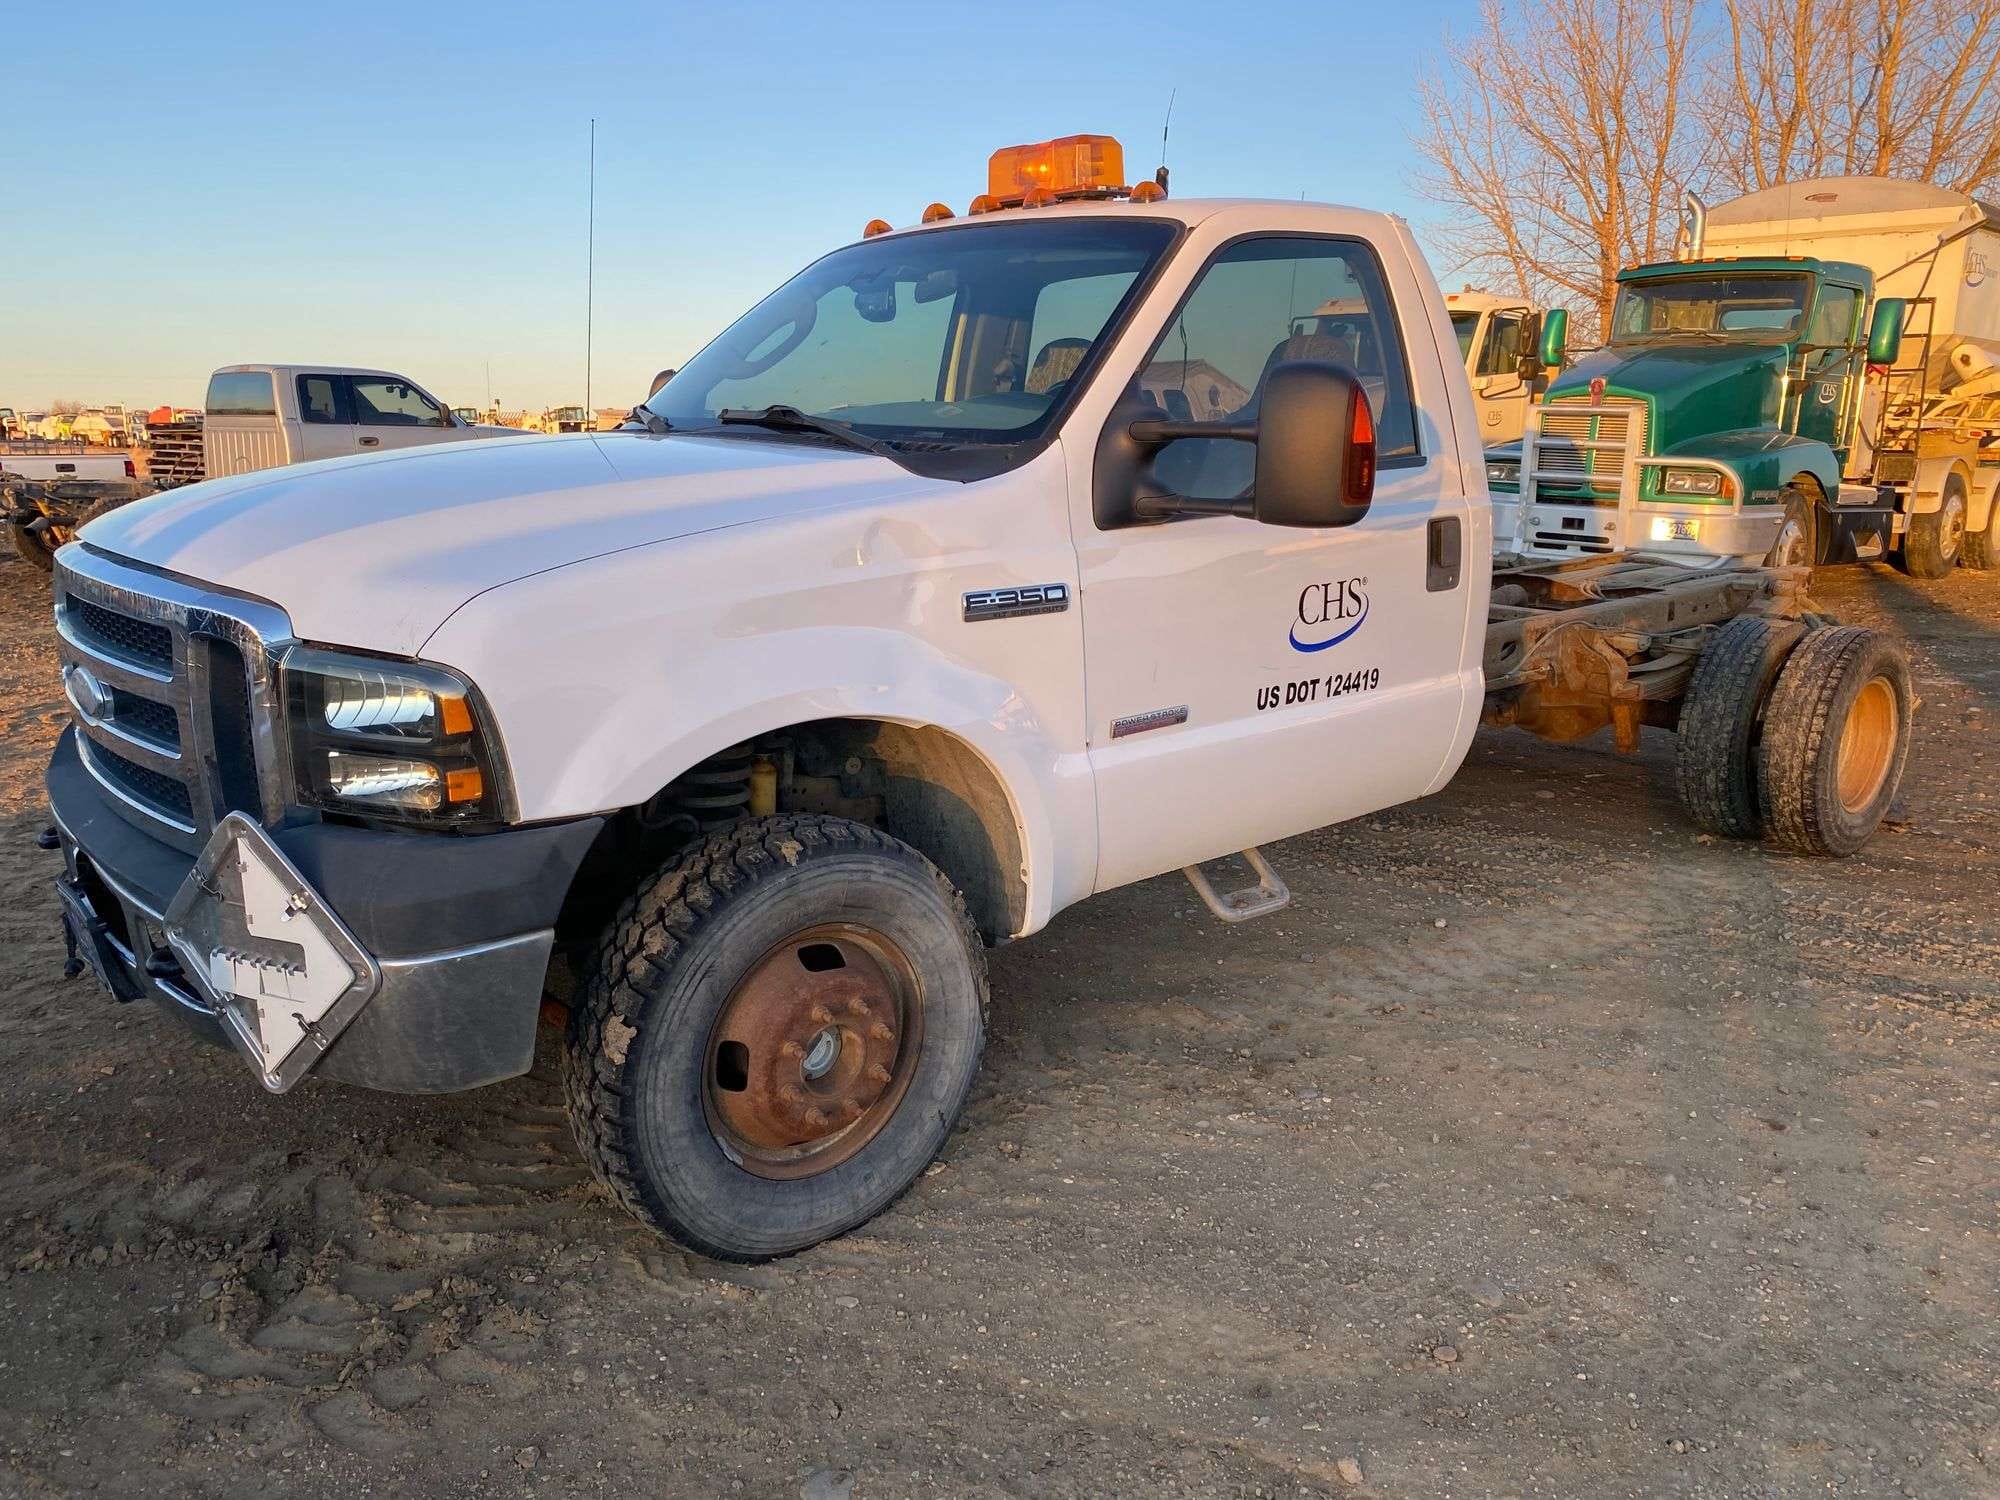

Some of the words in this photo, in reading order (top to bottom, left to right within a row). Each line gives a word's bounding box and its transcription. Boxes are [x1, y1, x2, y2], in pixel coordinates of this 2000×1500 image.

[966, 585, 1066, 611] F-350
[1256, 685, 1281, 710] US
[1286, 678, 1320, 704] DOT
[1325, 668, 1380, 697] 124419
